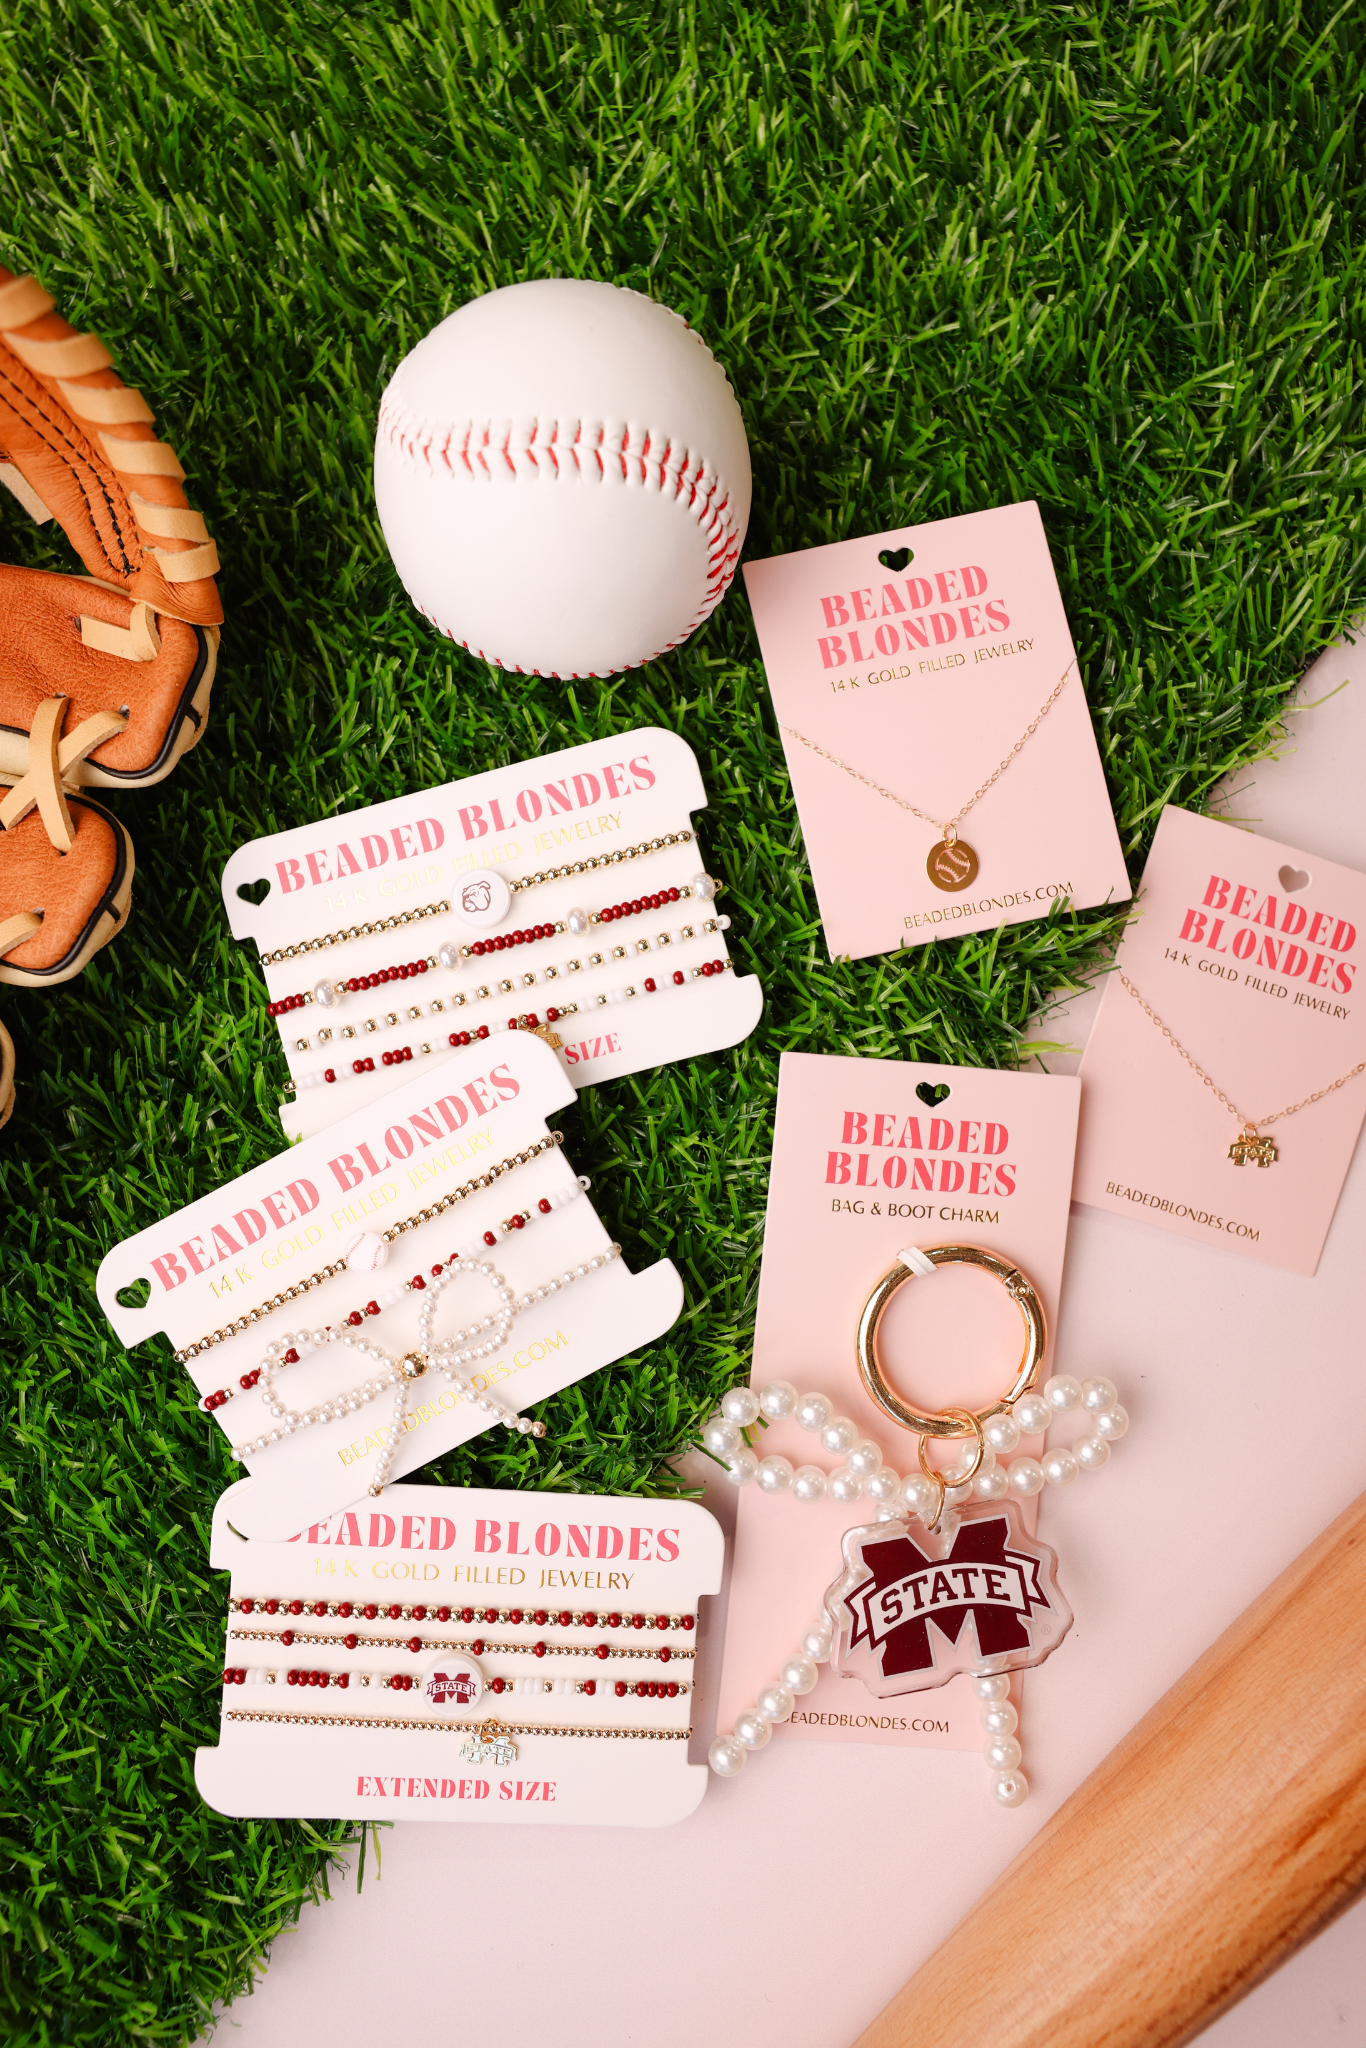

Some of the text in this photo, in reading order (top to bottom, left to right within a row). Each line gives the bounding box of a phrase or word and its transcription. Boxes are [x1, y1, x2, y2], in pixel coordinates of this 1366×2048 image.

[820, 565, 988, 629] BEADED
[816, 599, 1011, 669] BLONDES
[868, 664, 911, 684] GOLD
[920, 653, 966, 674] FILLED
[974, 638, 1035, 663] JEWELRY
[275, 755, 657, 895] BEADED BLONDES
[379, 865, 442, 896] GOLD
[453, 842, 522, 876] FILLED
[534, 811, 623, 855] JEWELRY
[904, 882, 1074, 929] BEADEDBLONDES.COM
[1201, 875, 1357, 953] BEADED
[1178, 908, 1357, 995] BLONDES
[1198, 960, 1239, 982] GOLD
[1245, 974, 1288, 999] FILLED
[1293, 991, 1351, 1020] JEWELRY
[564, 1032, 622, 1065] SIZE
[841, 1111, 1010, 1155] BEADED
[149, 1063, 520, 1292] BEADED BLONDES
[261, 1225, 324, 1269] GOLD
[331, 1183, 400, 1230] FILLED
[407, 1126, 495, 1192] JEWELRY
[824, 1150, 1017, 1197] BLONDES
[831, 1198, 1000, 1224] BAG & BOOT CHARM
[1106, 1181, 1261, 1242] BEADEDBLONDES.COM
[338, 1330, 569, 1467] BEADDBLODES.COM
[284, 1512, 680, 1564] EADED BLONDES
[372, 1561, 440, 1580] GOLD
[454, 1565, 526, 1586] FILLED
[538, 1569, 634, 1591] JEWELRY
[881, 1567, 1011, 1625] STATE
[435, 1682, 467, 1692] STATE
[783, 1711, 949, 1733] EADEDBLONDES.COM
[356, 1776, 557, 1802] EXTENDED SIZE
